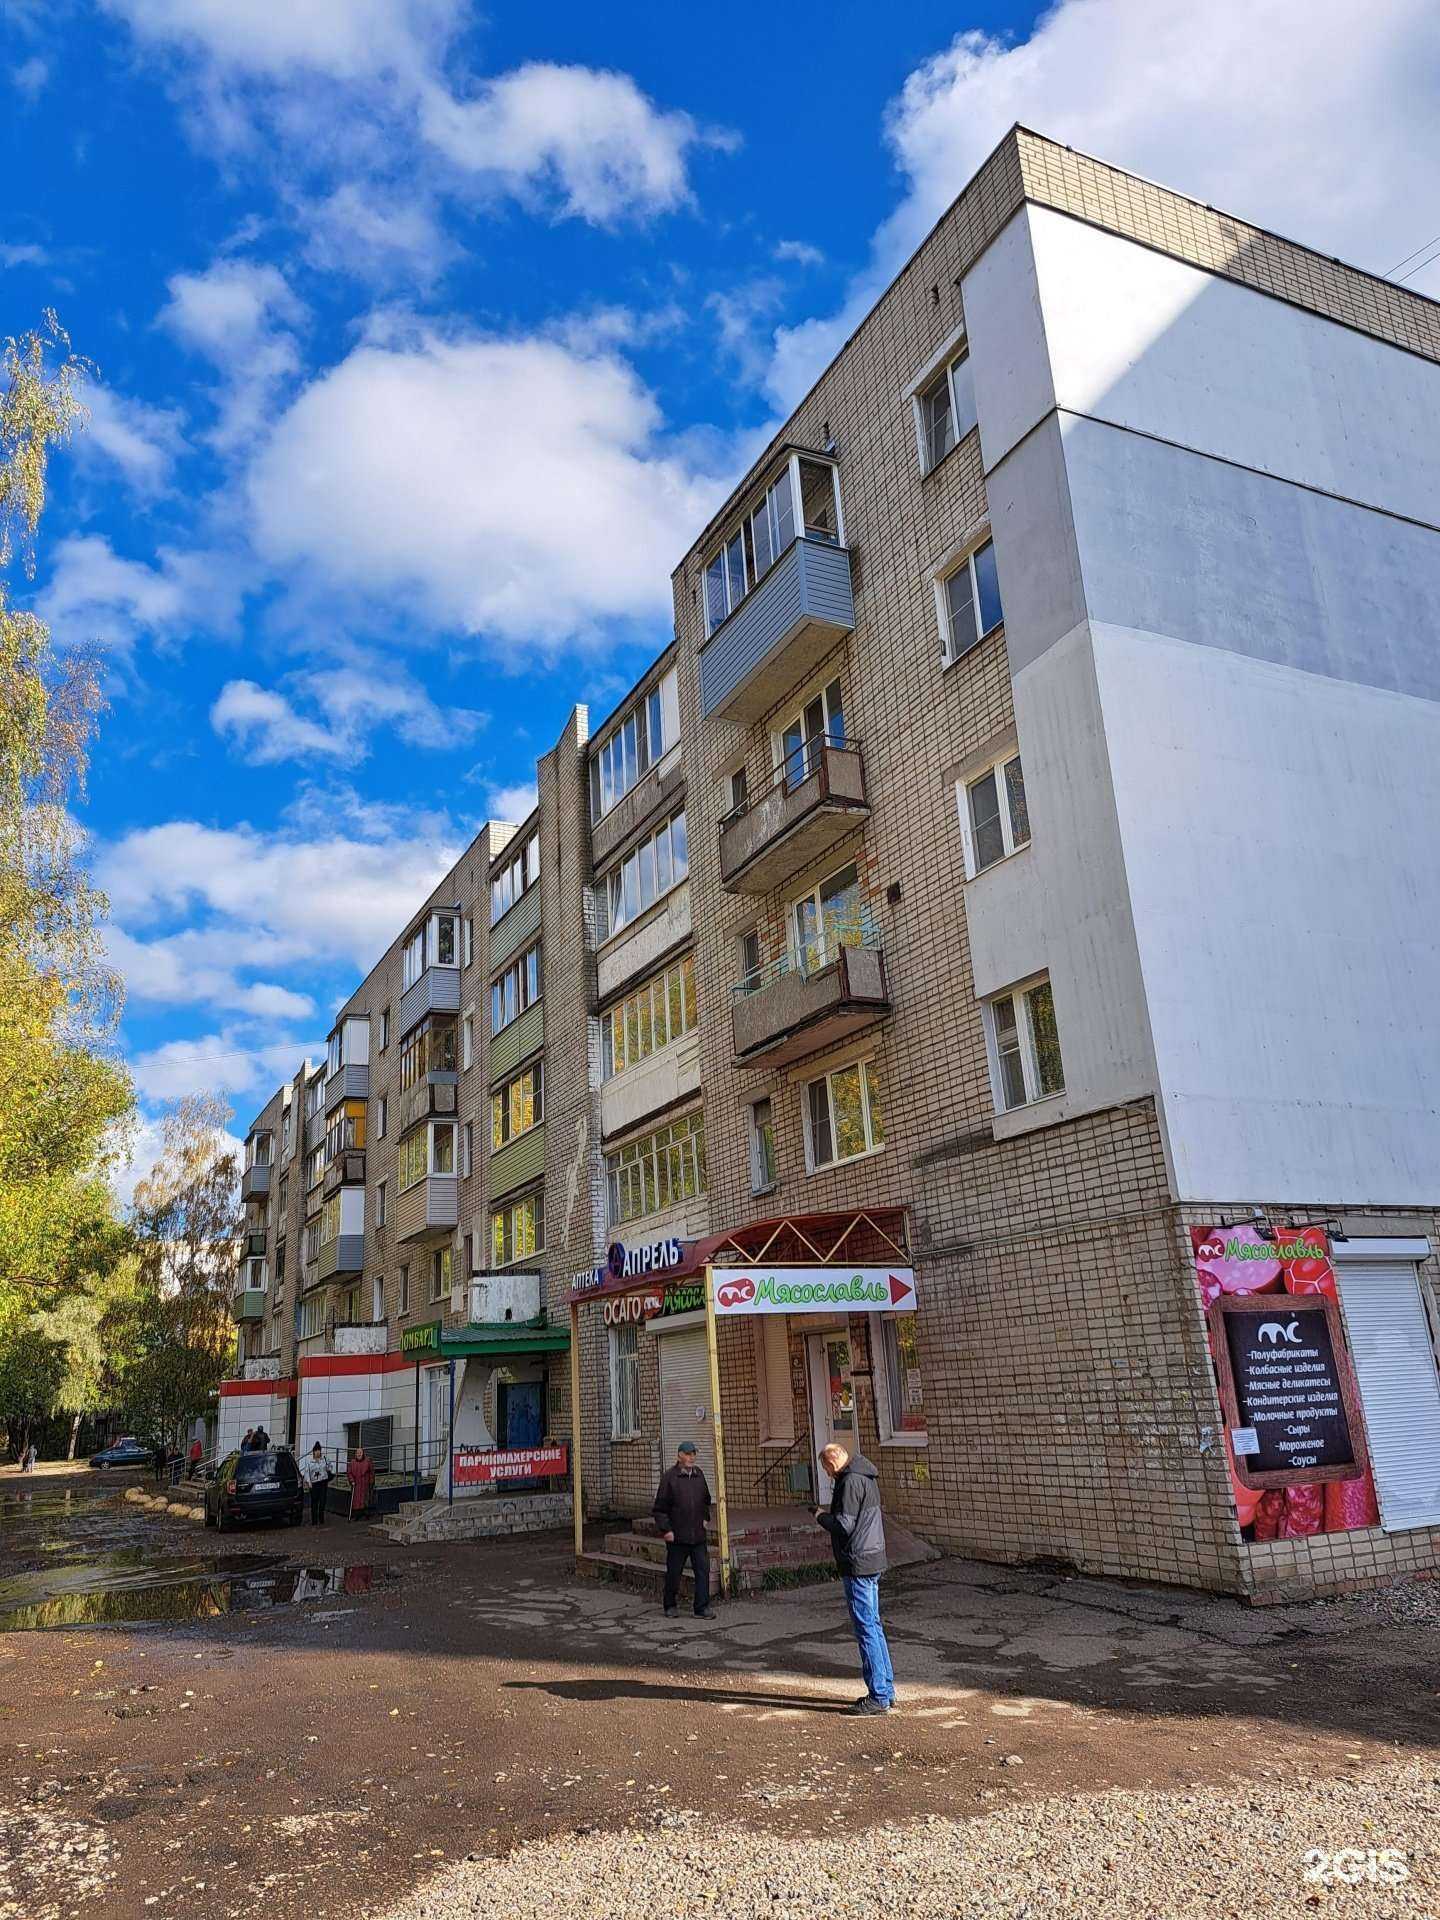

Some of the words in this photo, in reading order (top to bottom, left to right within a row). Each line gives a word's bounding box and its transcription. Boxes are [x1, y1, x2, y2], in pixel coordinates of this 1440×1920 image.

[622, 1240, 679, 1277] АПРЕЛЬ
[1224, 1236, 1325, 1262] Мясославль
[571, 1269, 599, 1292] АПТЕКА
[753, 1275, 889, 1306] Мясославль
[603, 1296, 642, 1325] ОСАГО
[400, 1327, 433, 1351] ЛОМБАРД
[1294, 1362, 1325, 1373] изделия
[1282, 1378, 1331, 1389] деликатесы
[1307, 1391, 1338, 1402] изделия
[1296, 1407, 1338, 1420] продукты
[459, 1448, 561, 1467] ПАРИКМАХЕРСКИЕ
[490, 1463, 532, 1478] УСЛУГИ
